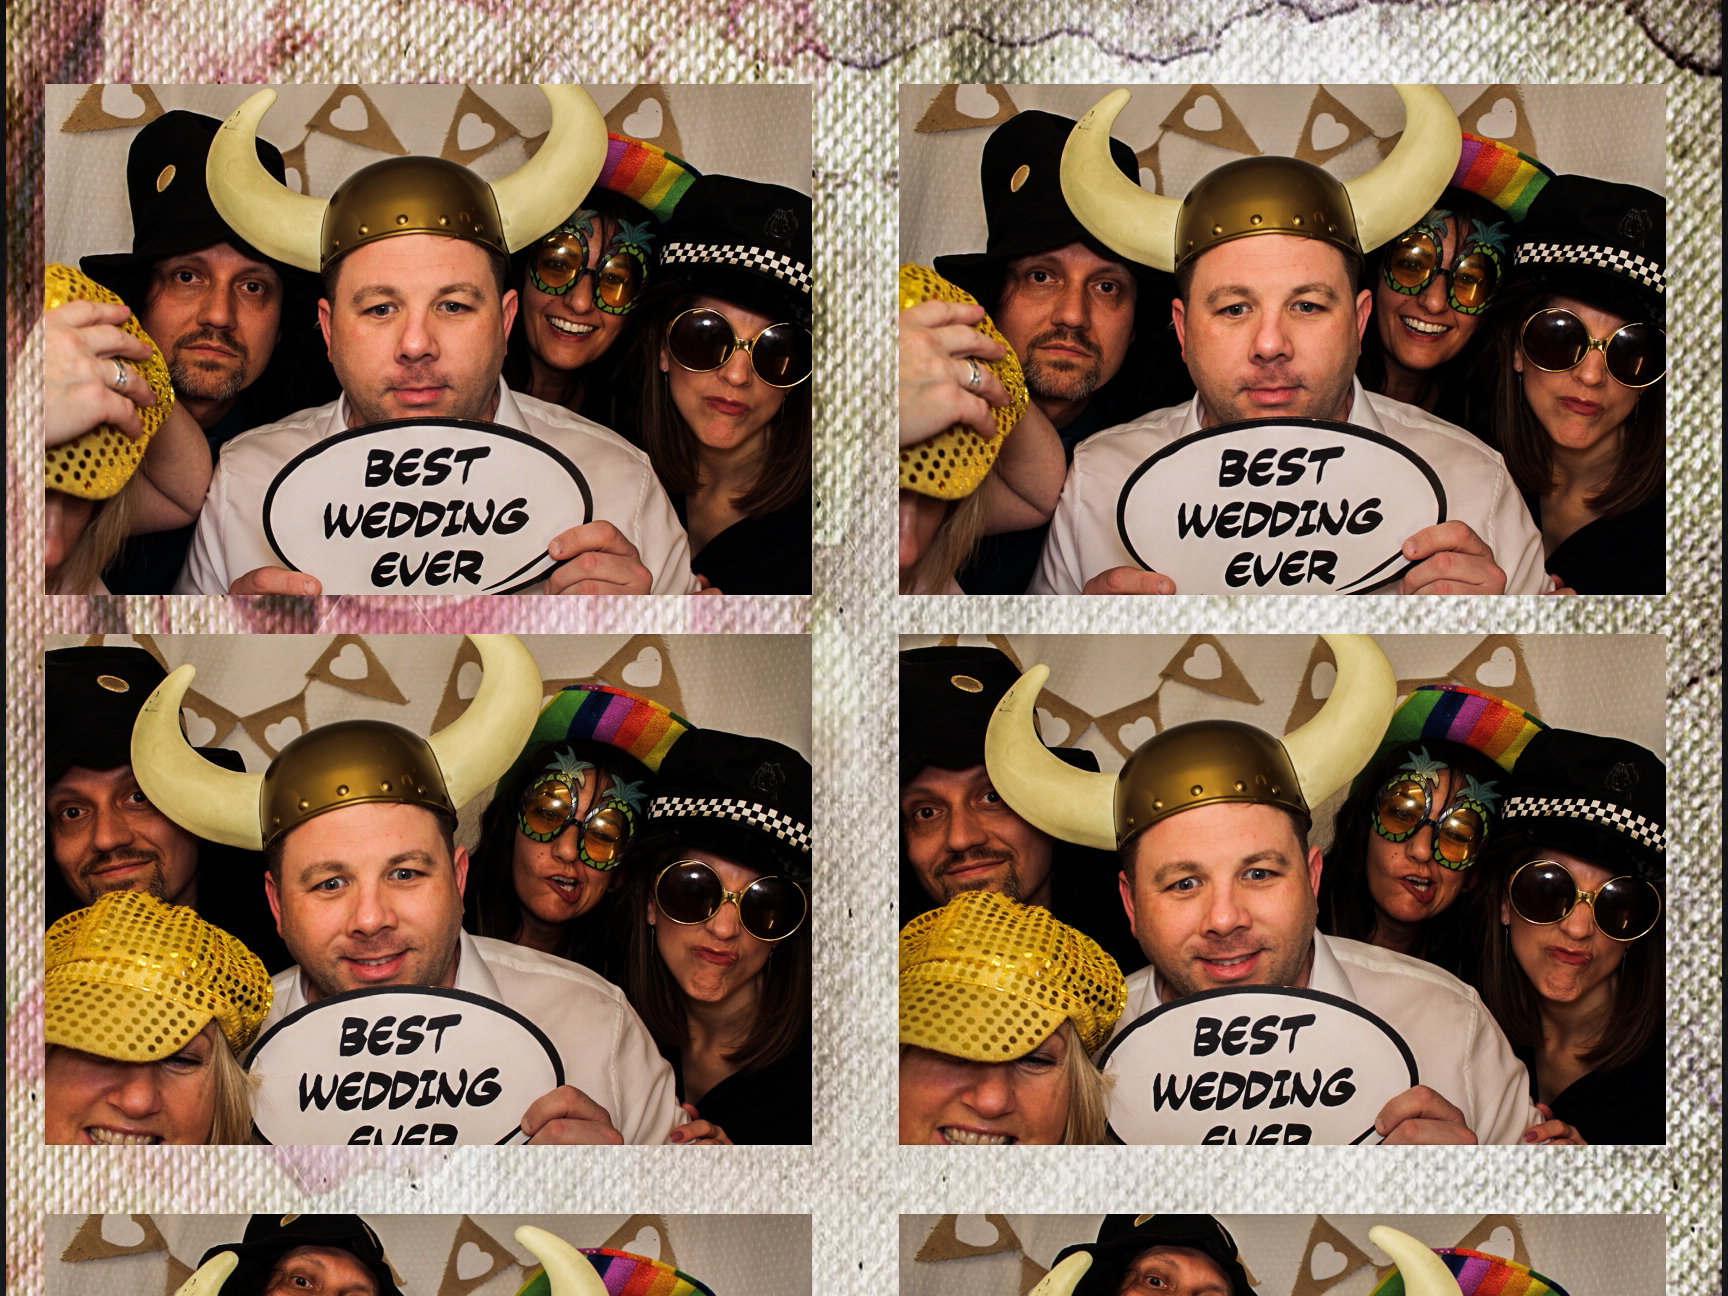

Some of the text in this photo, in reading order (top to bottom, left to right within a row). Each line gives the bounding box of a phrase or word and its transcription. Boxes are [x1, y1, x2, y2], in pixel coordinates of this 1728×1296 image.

[364, 447, 491, 488] BEST
[1218, 447, 1345, 488] BEST
[323, 497, 529, 540] WEDDING
[1177, 497, 1383, 540] WEDDING
[370, 549, 484, 588] EVER
[1224, 549, 1338, 588] EVER
[339, 1013, 463, 1057] BEST
[1193, 1013, 1317, 1057] BEST
[298, 1067, 503, 1112] WEDDING
[1152, 1067, 1357, 1112] WEDDING
